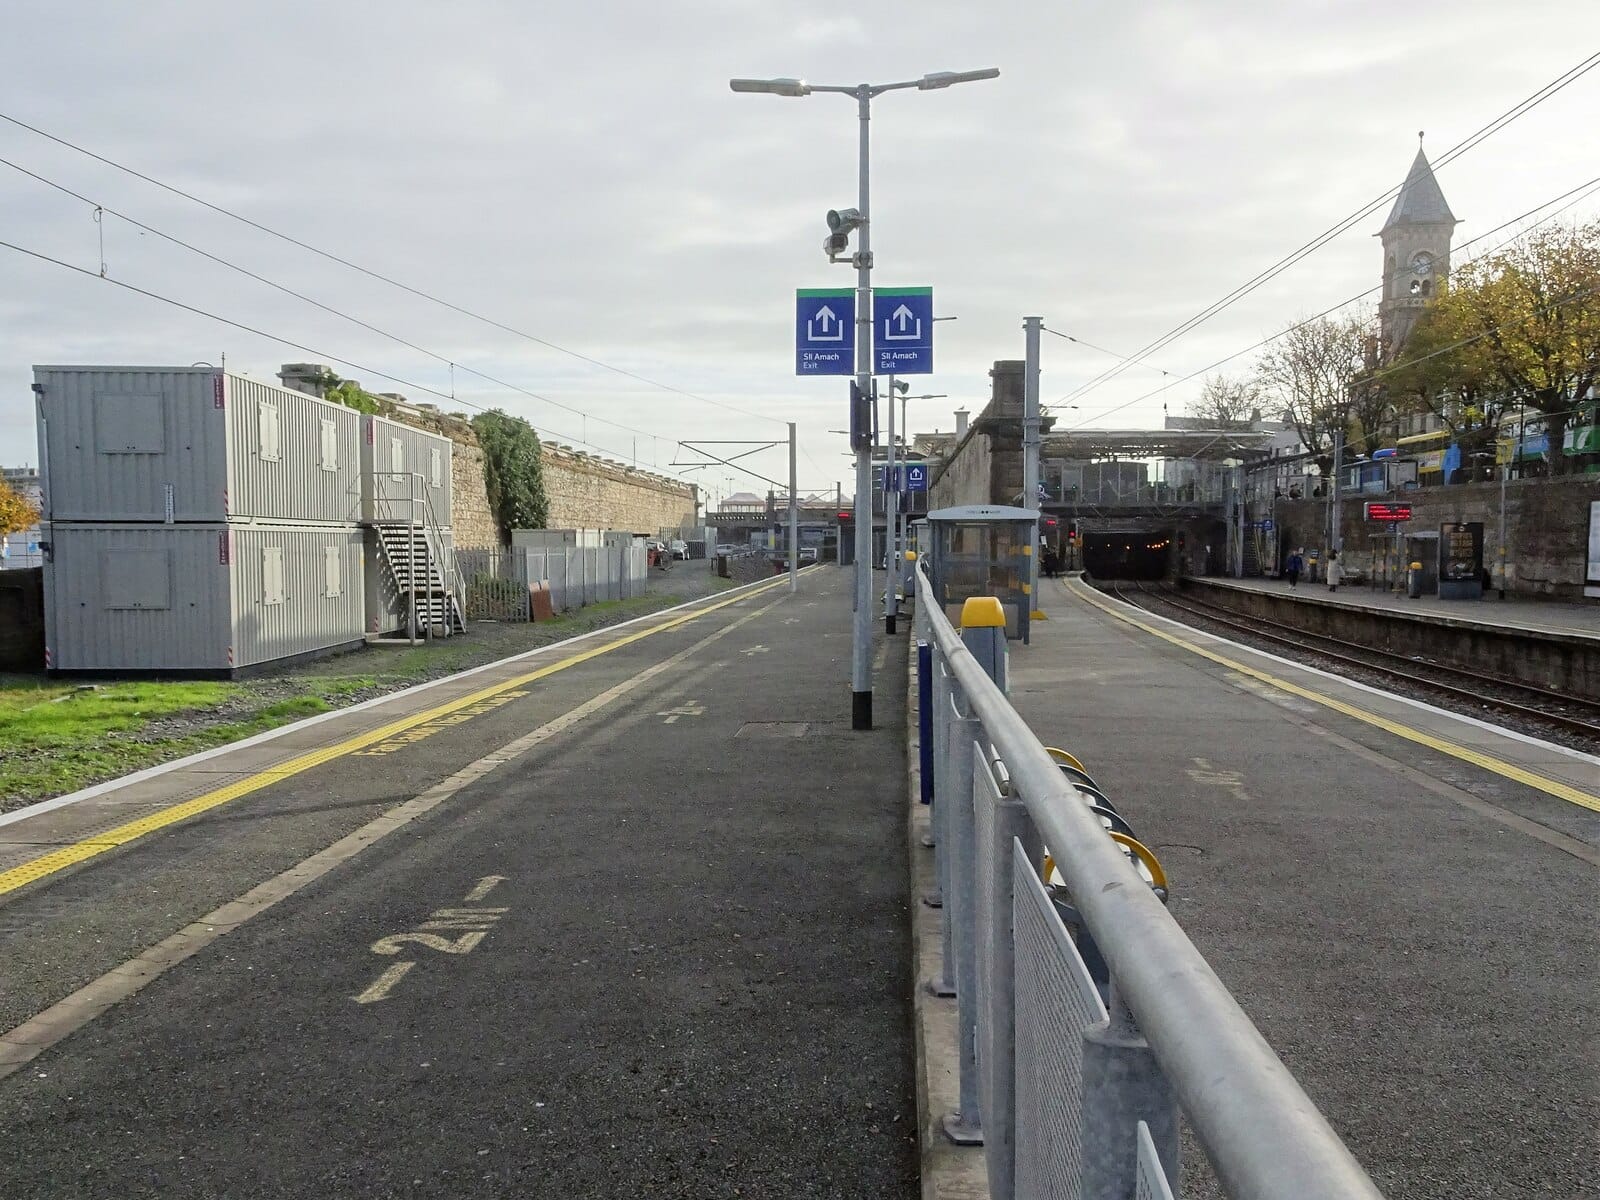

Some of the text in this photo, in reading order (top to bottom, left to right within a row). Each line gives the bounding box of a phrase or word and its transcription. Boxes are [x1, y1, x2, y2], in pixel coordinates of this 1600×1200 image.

[814, 352, 840, 361] Amach
[892, 351, 918, 360] Amach
[803, 361, 818, 369] Exit
[881, 361, 896, 369] Exit
